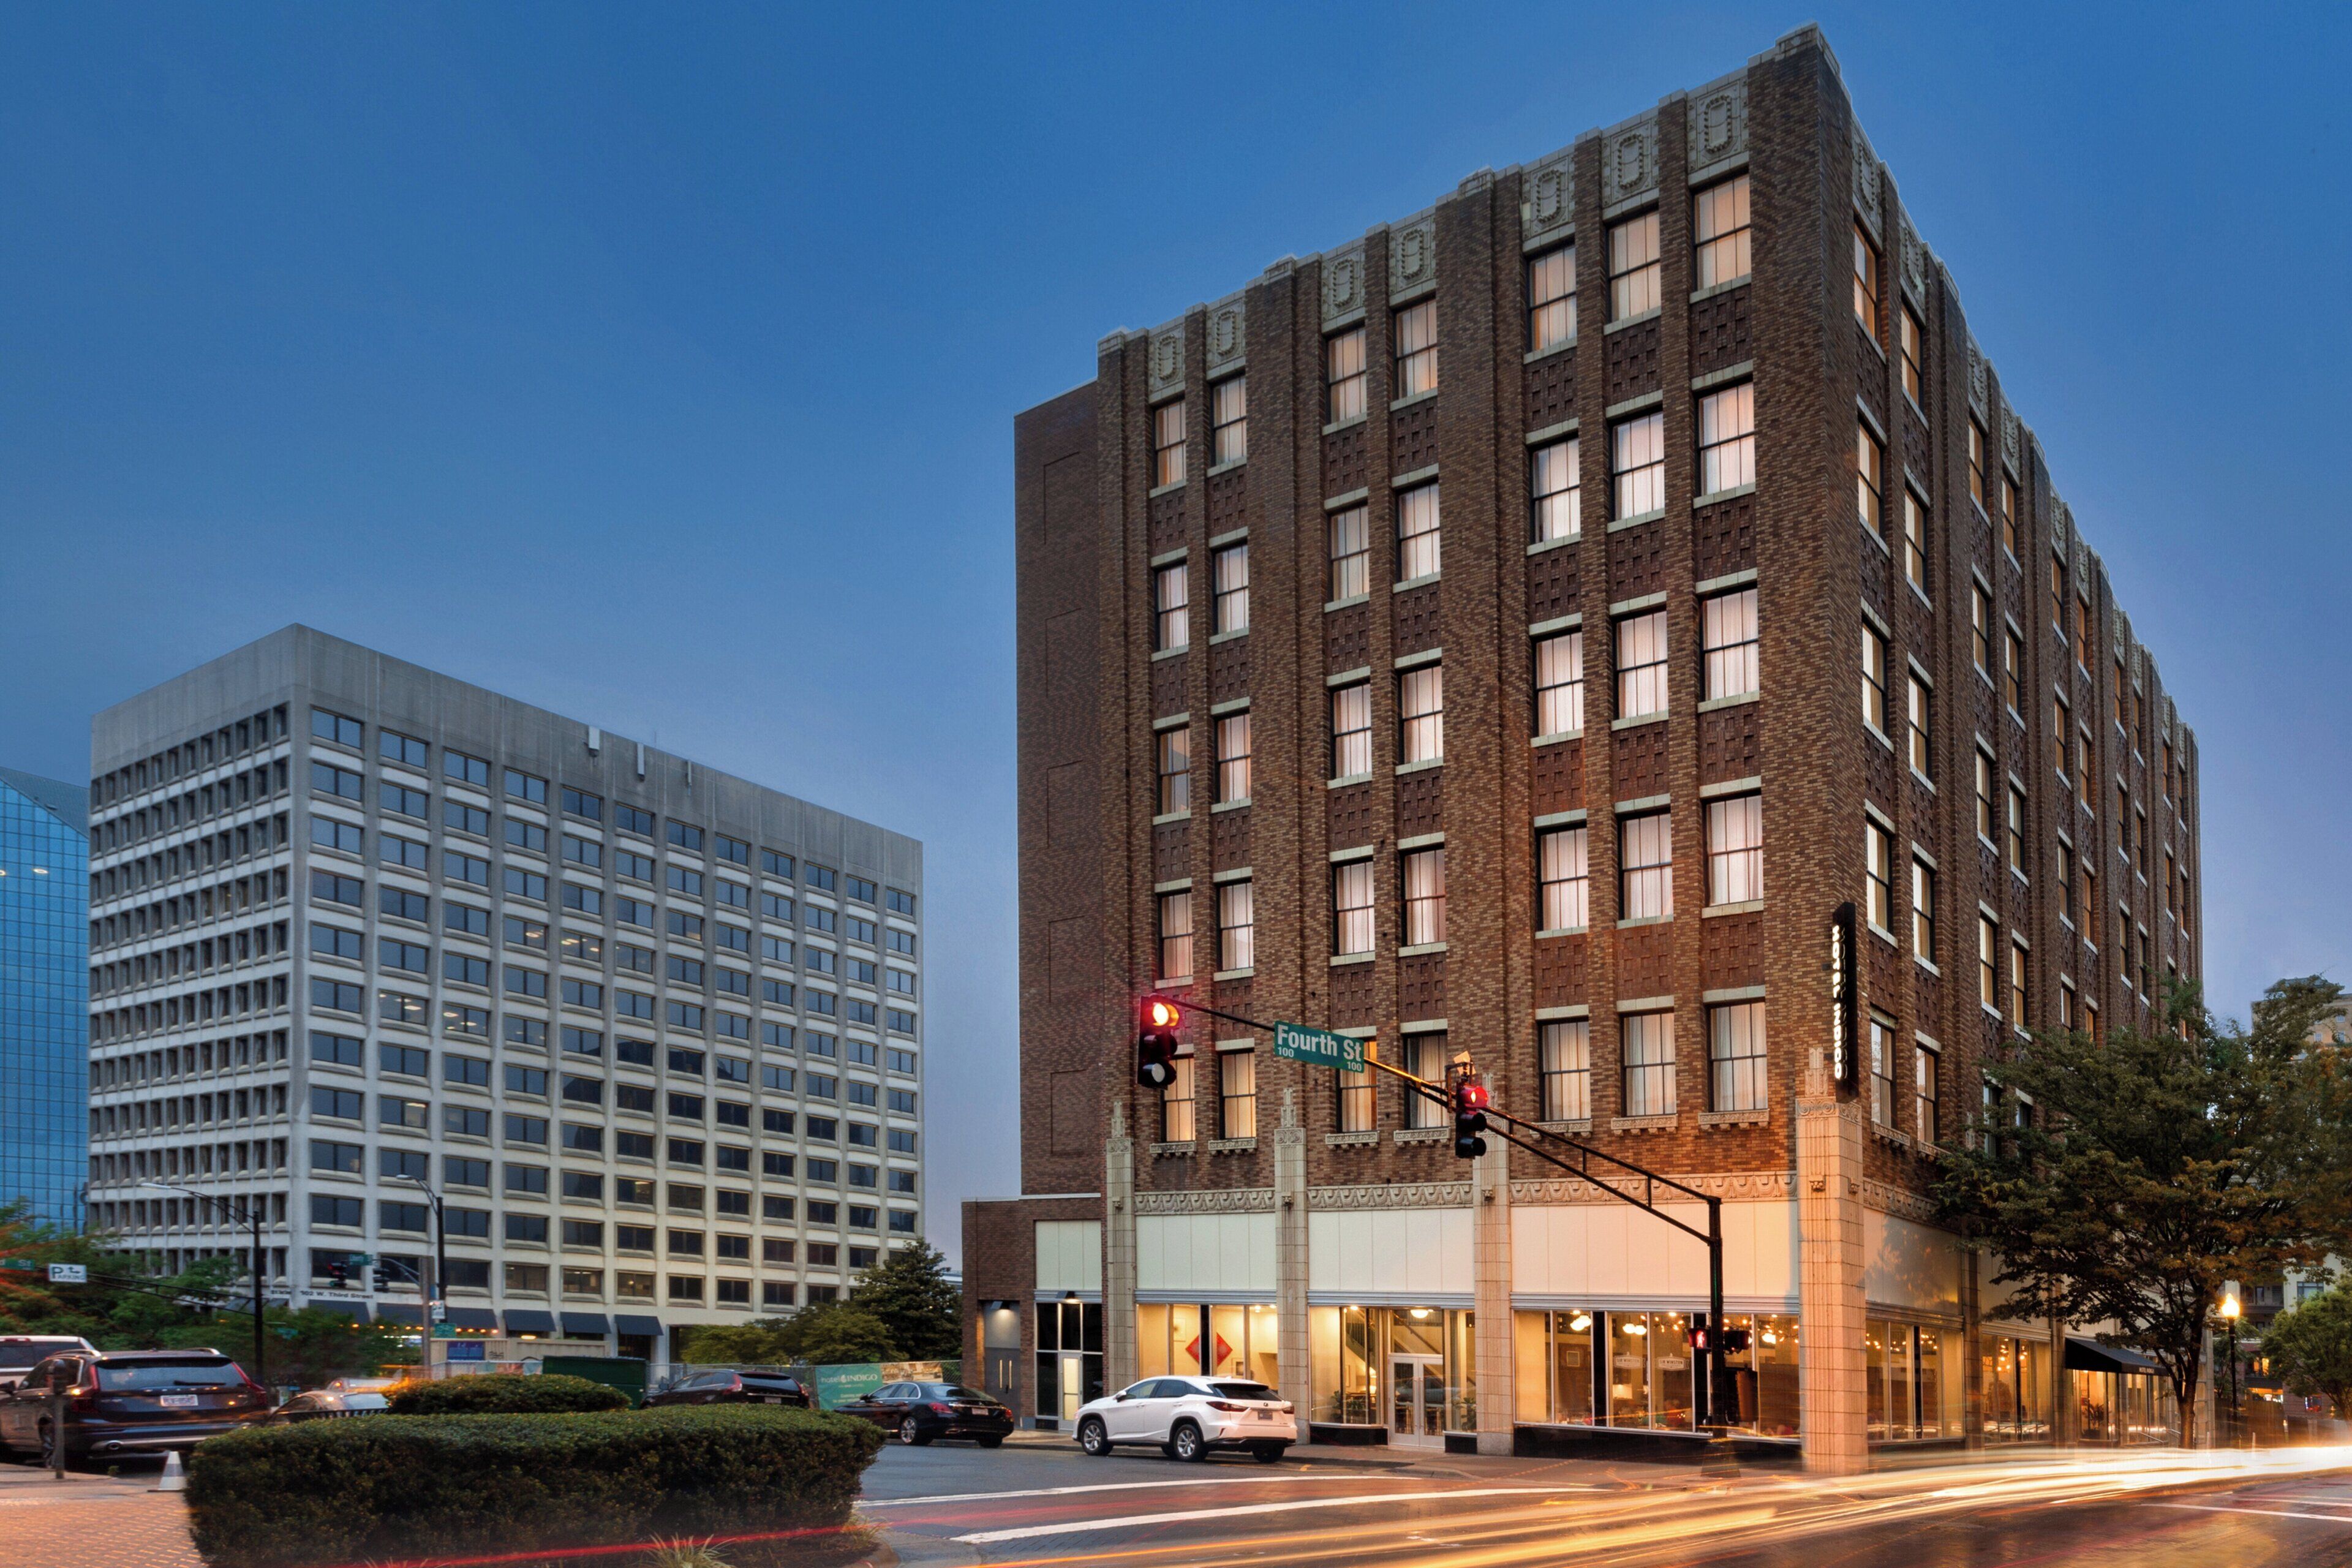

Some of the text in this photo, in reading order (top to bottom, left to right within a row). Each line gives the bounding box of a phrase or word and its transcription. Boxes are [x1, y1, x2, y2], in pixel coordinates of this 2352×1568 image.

[1832, 925, 1842, 1079] HOTEL INDIGO
[1278, 1024, 1362, 1061] Fourth St
[1278, 1047, 1294, 1058] 100
[1347, 1061, 1362, 1071] 100
